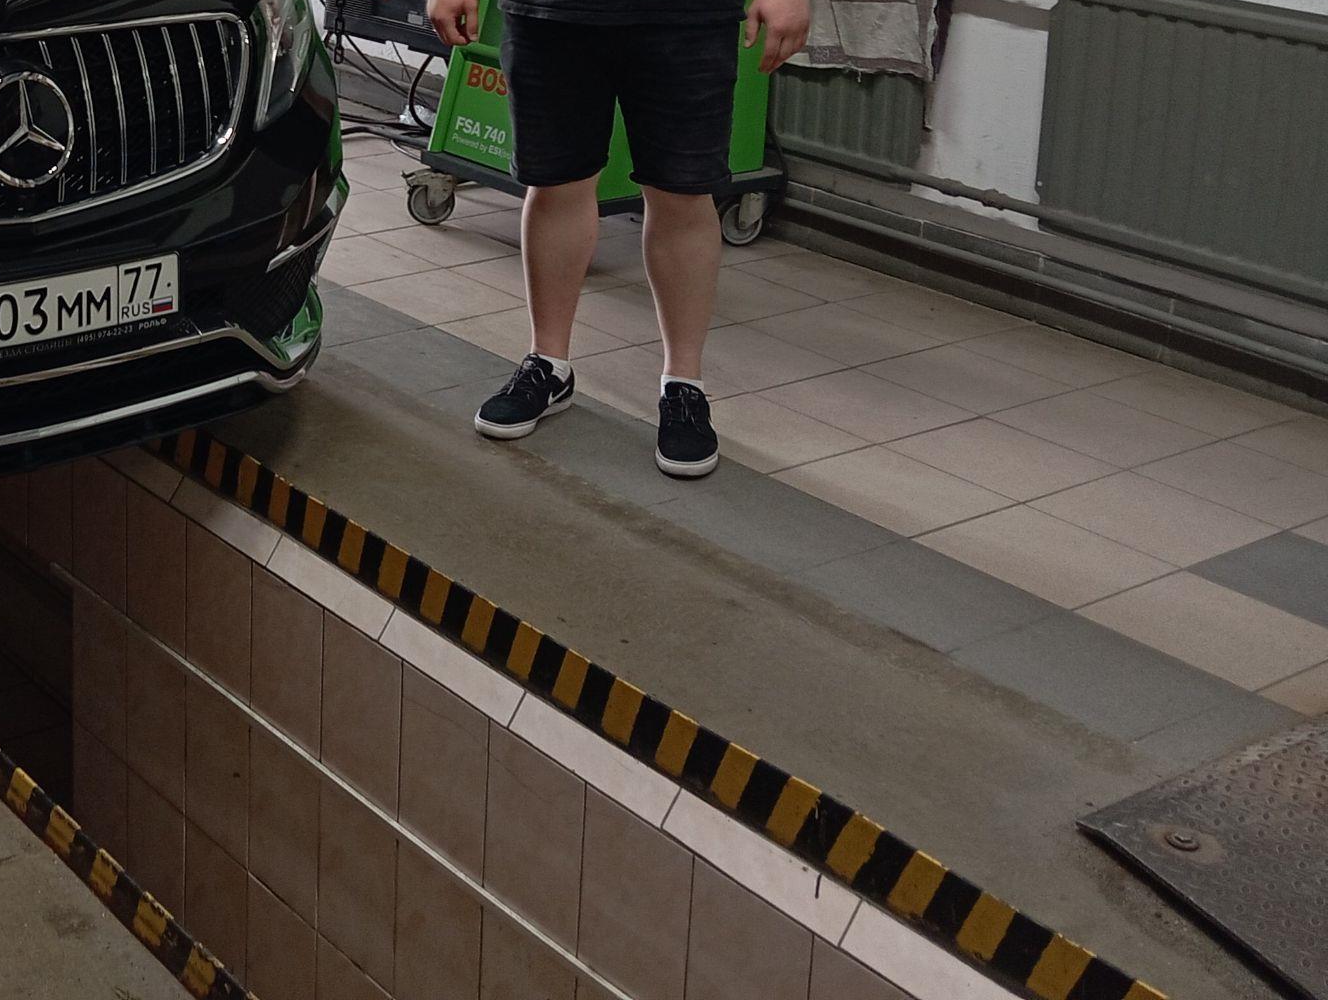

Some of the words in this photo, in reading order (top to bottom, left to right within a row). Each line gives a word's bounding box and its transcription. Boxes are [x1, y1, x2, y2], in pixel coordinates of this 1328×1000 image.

[467, 63, 509, 96] BOS
[455, 116, 481, 137] FSA
[483, 125, 506, 144] 740
[124, 262, 162, 303] 77
[121, 301, 151, 319] RUS
[139, 318, 167, 330] РОЛЬФ
